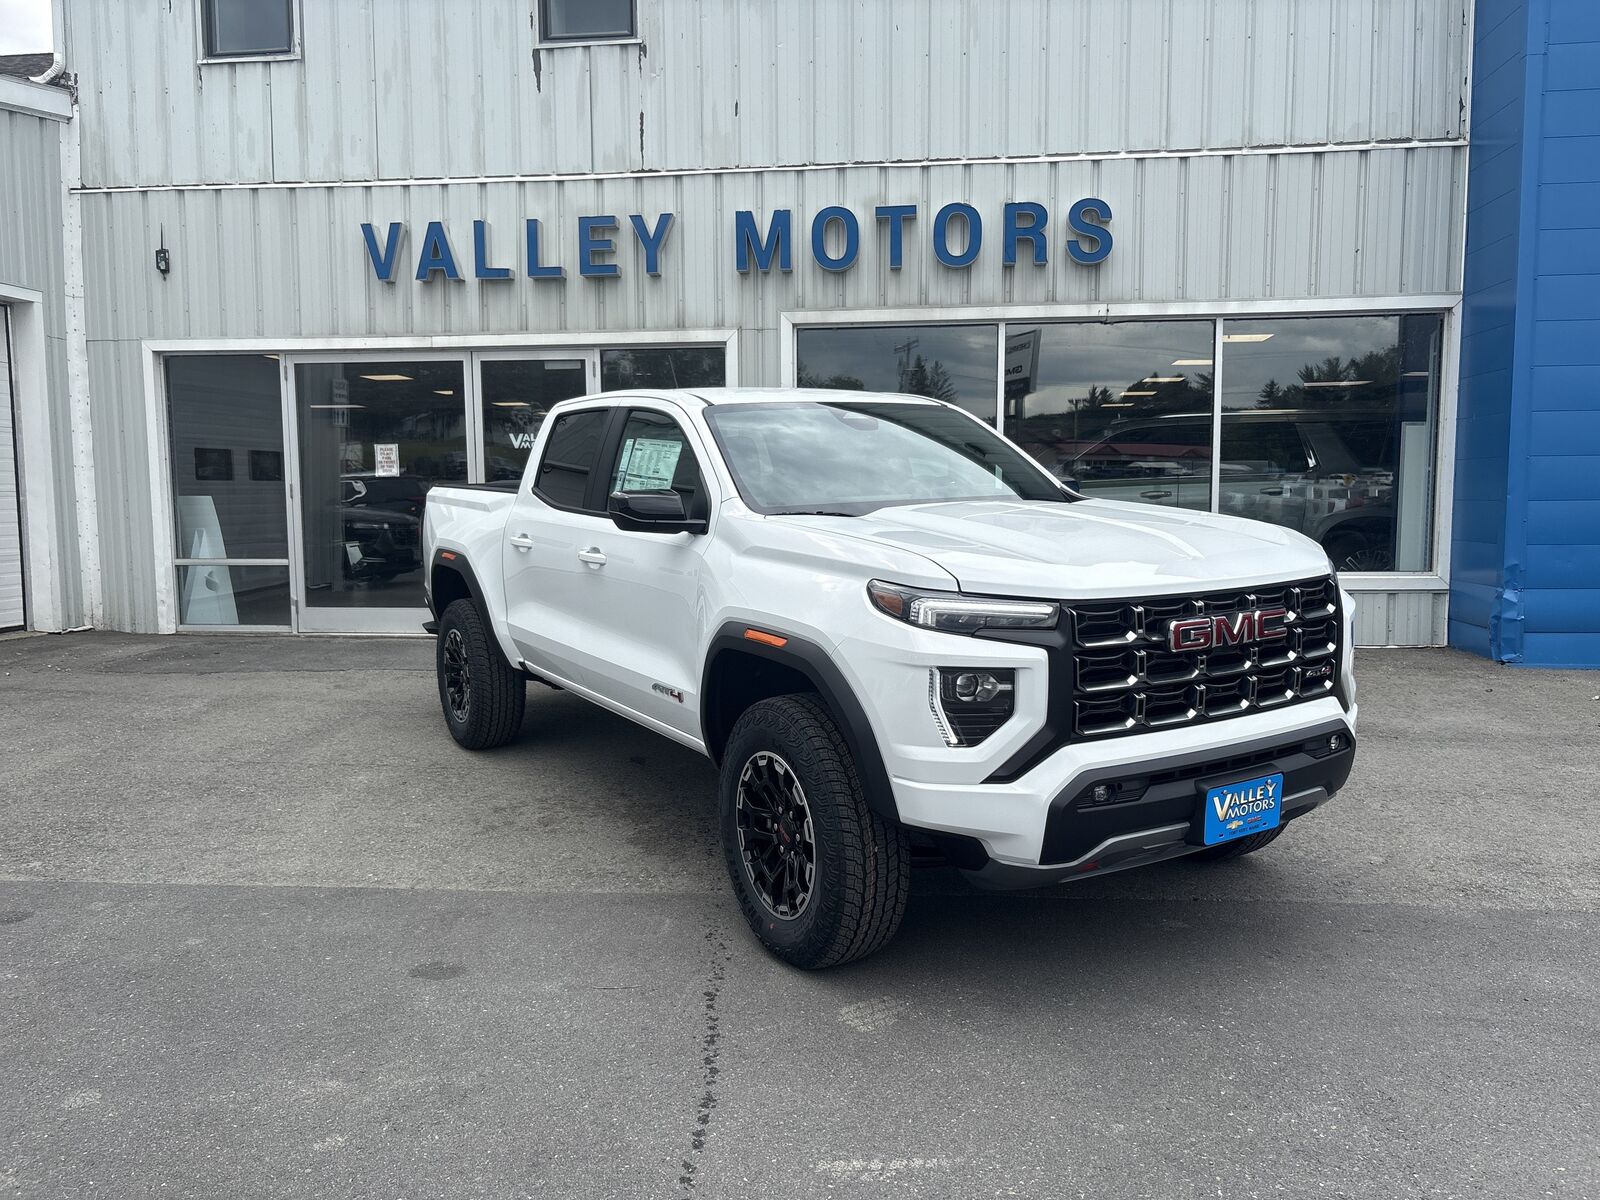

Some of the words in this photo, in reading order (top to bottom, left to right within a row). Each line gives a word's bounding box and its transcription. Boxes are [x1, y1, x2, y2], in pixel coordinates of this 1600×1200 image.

[360, 212, 675, 282] VALLEY
[736, 198, 1114, 273] MOTORS
[509, 433, 537, 449] VAL
[1170, 608, 1287, 652] GMC
[1213, 783, 1277, 821] VALLEY
[1226, 798, 1275, 819] MOTORS
